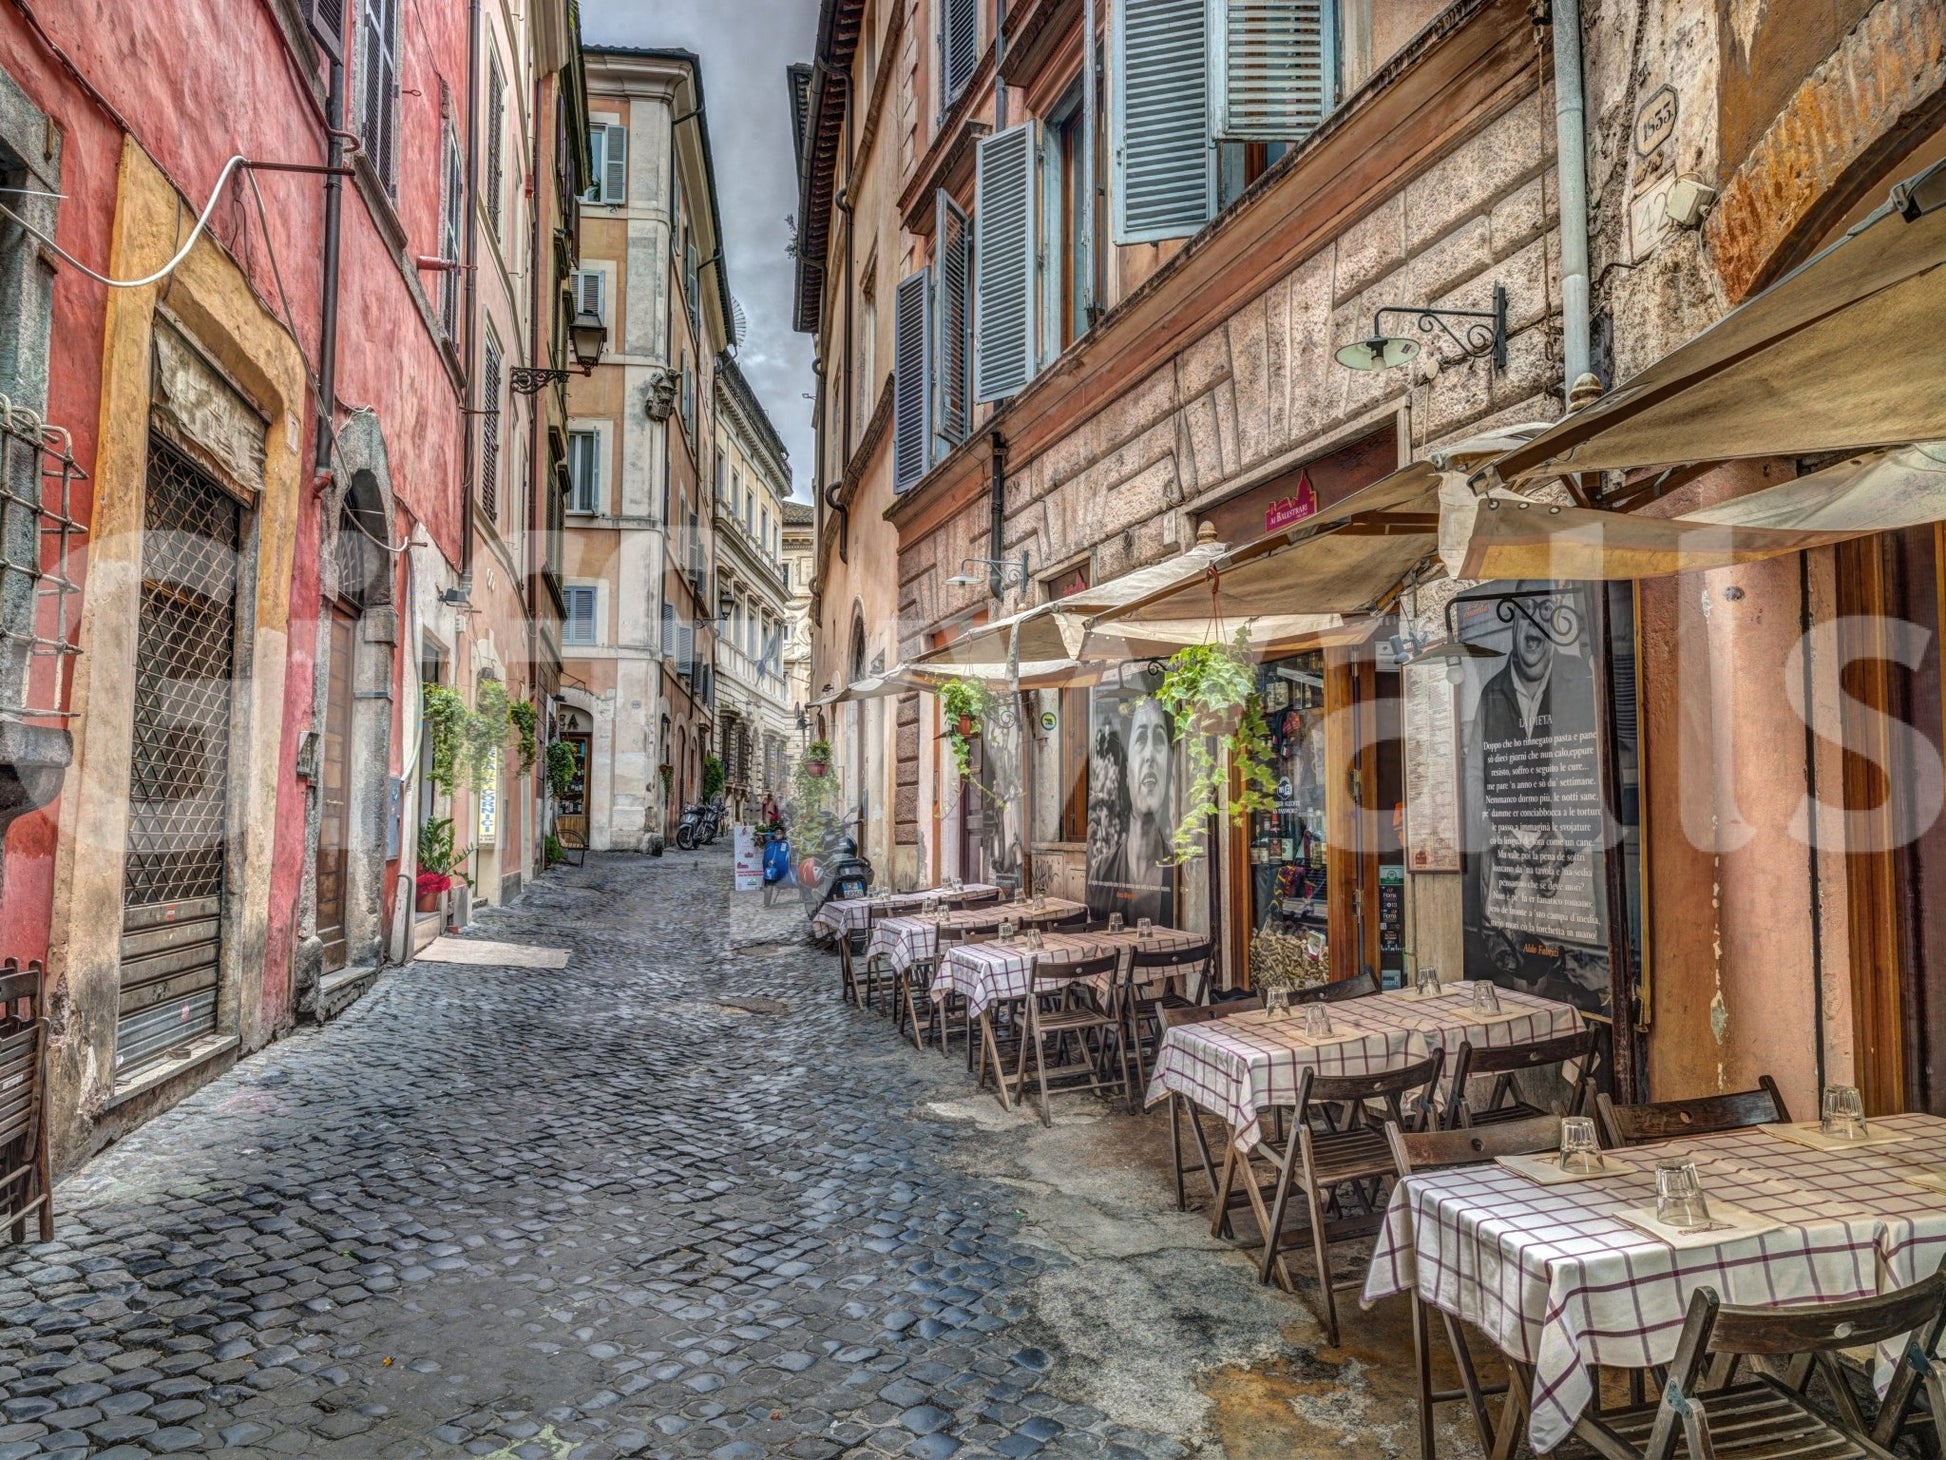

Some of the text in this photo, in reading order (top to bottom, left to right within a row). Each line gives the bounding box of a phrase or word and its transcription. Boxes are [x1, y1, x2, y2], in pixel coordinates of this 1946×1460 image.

[1483, 741, 1502, 752] Doppo
[1502, 738, 1513, 749] che
[1513, 737, 1522, 747] ho
[1553, 733, 1572, 746] pasta
[1509, 752, 1527, 764] giorni
[1527, 750, 1539, 760] che
[1540, 751, 1553, 759] nun
[1511, 765, 1530, 775] soffro
[1535, 764, 1559, 776] seguito
[1559, 762, 1567, 772] le
[1517, 781, 1533, 789] anno
[1517, 793, 1539, 803] dormo
[1553, 791, 1560, 802] le
[1561, 791, 1579, 802] notti
[1569, 806, 1576, 816] le
